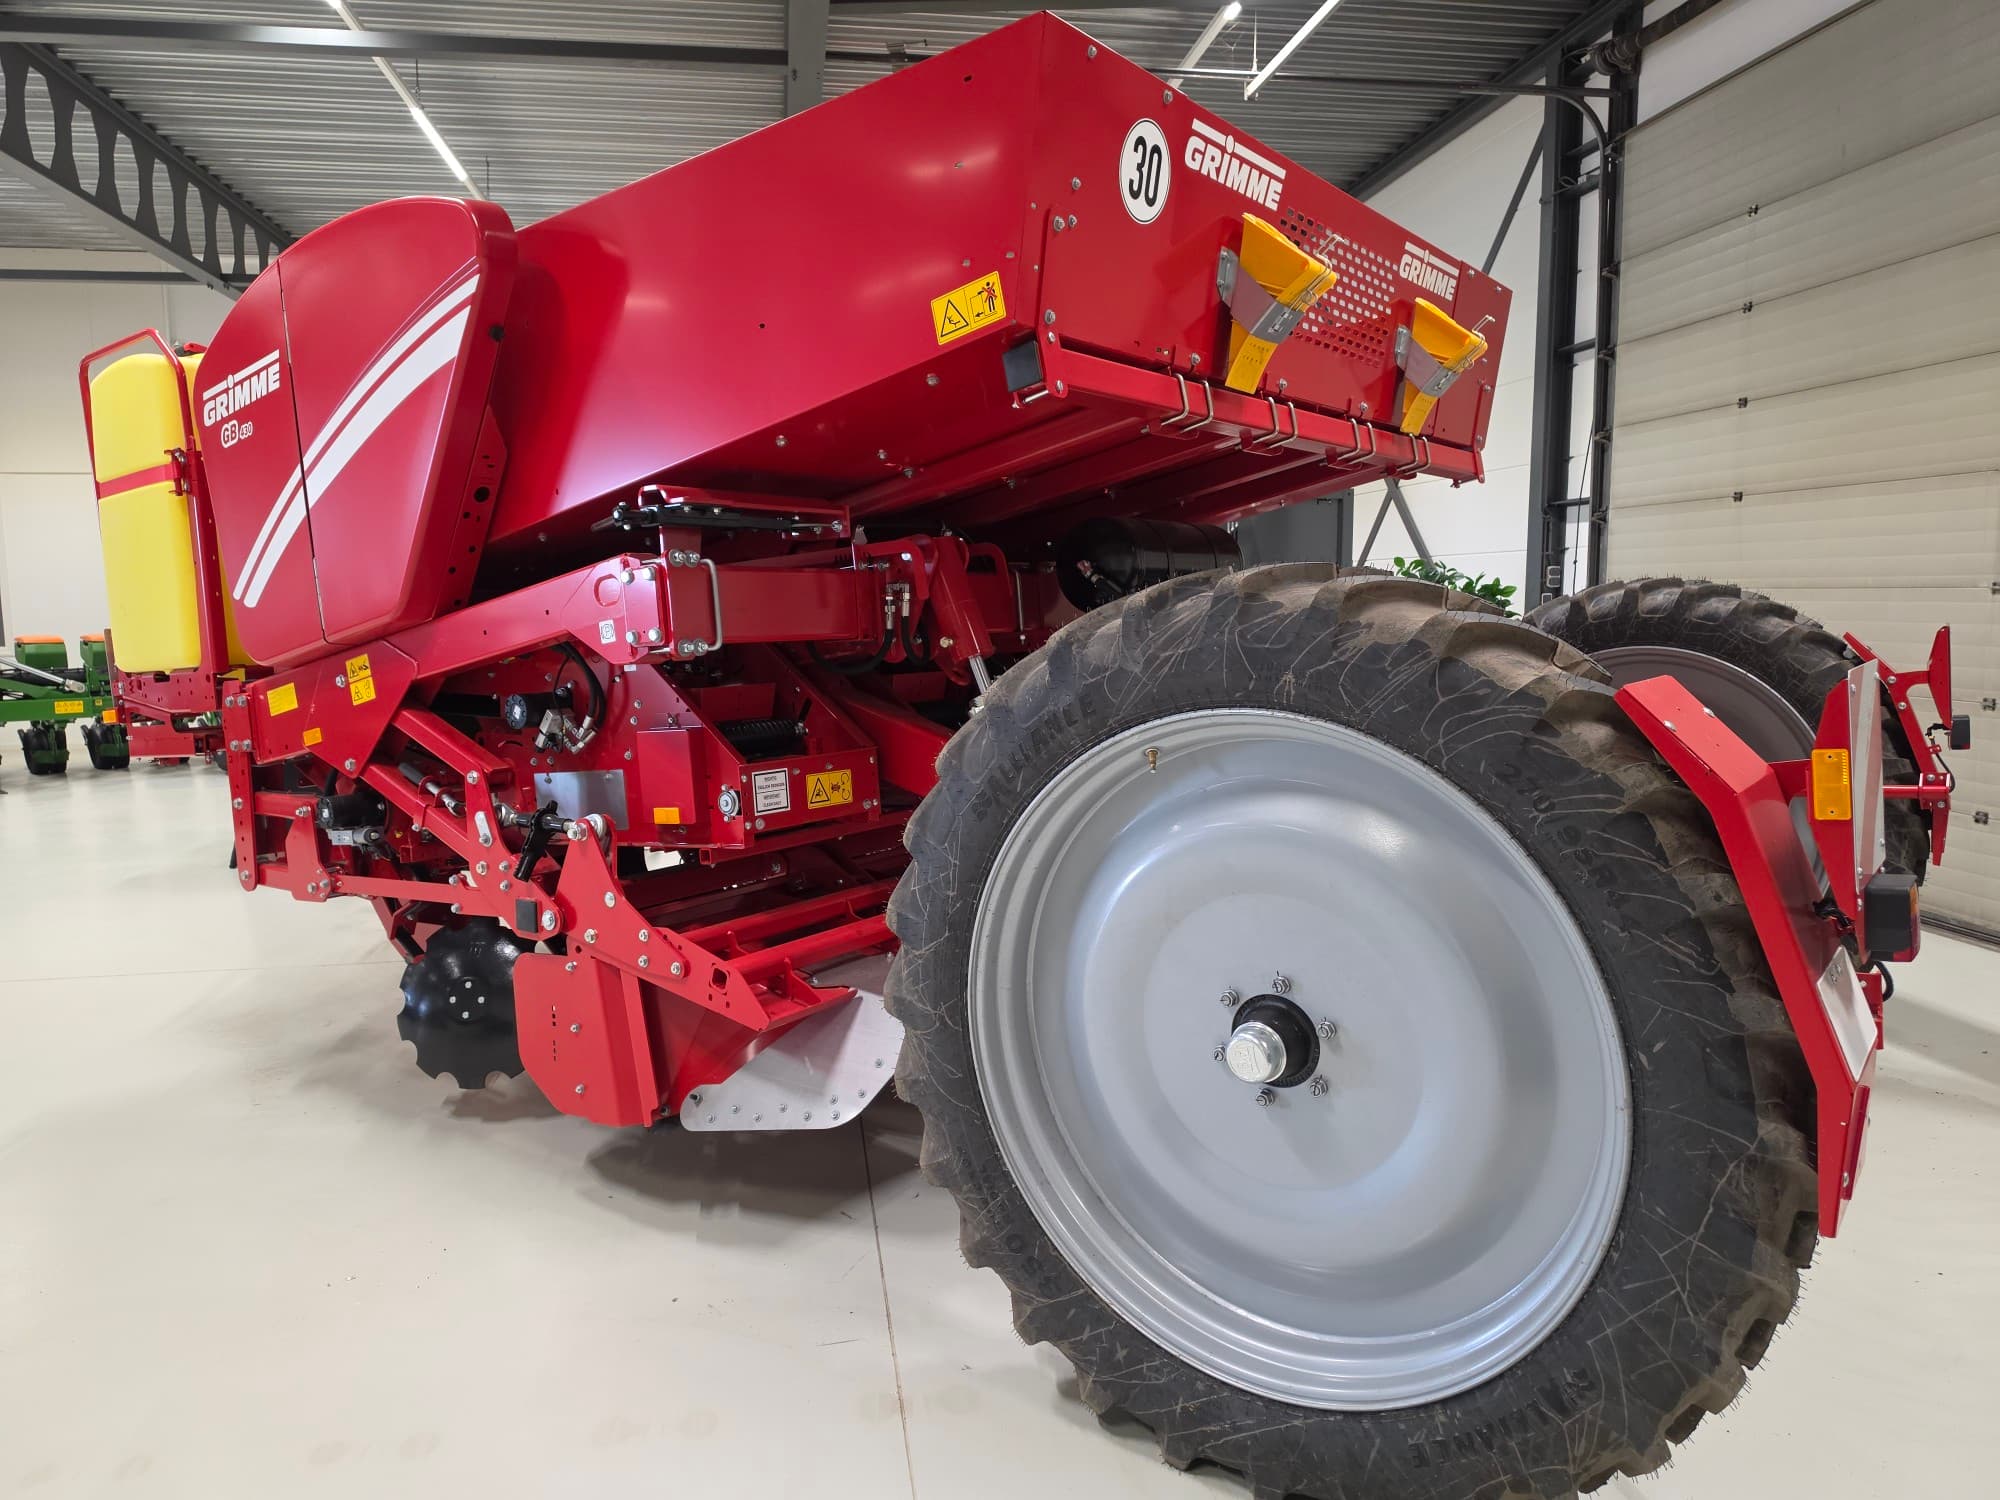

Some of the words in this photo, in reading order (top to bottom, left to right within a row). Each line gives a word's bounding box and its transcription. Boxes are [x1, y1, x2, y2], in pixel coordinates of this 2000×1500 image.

[1128, 135, 1162, 208] 30
[1184, 134, 1283, 212] GRIMME
[1399, 250, 1457, 302] GRIMME
[203, 361, 280, 427] GRIMME
[221, 419, 239, 449] GB
[239, 421, 253, 440] 430
